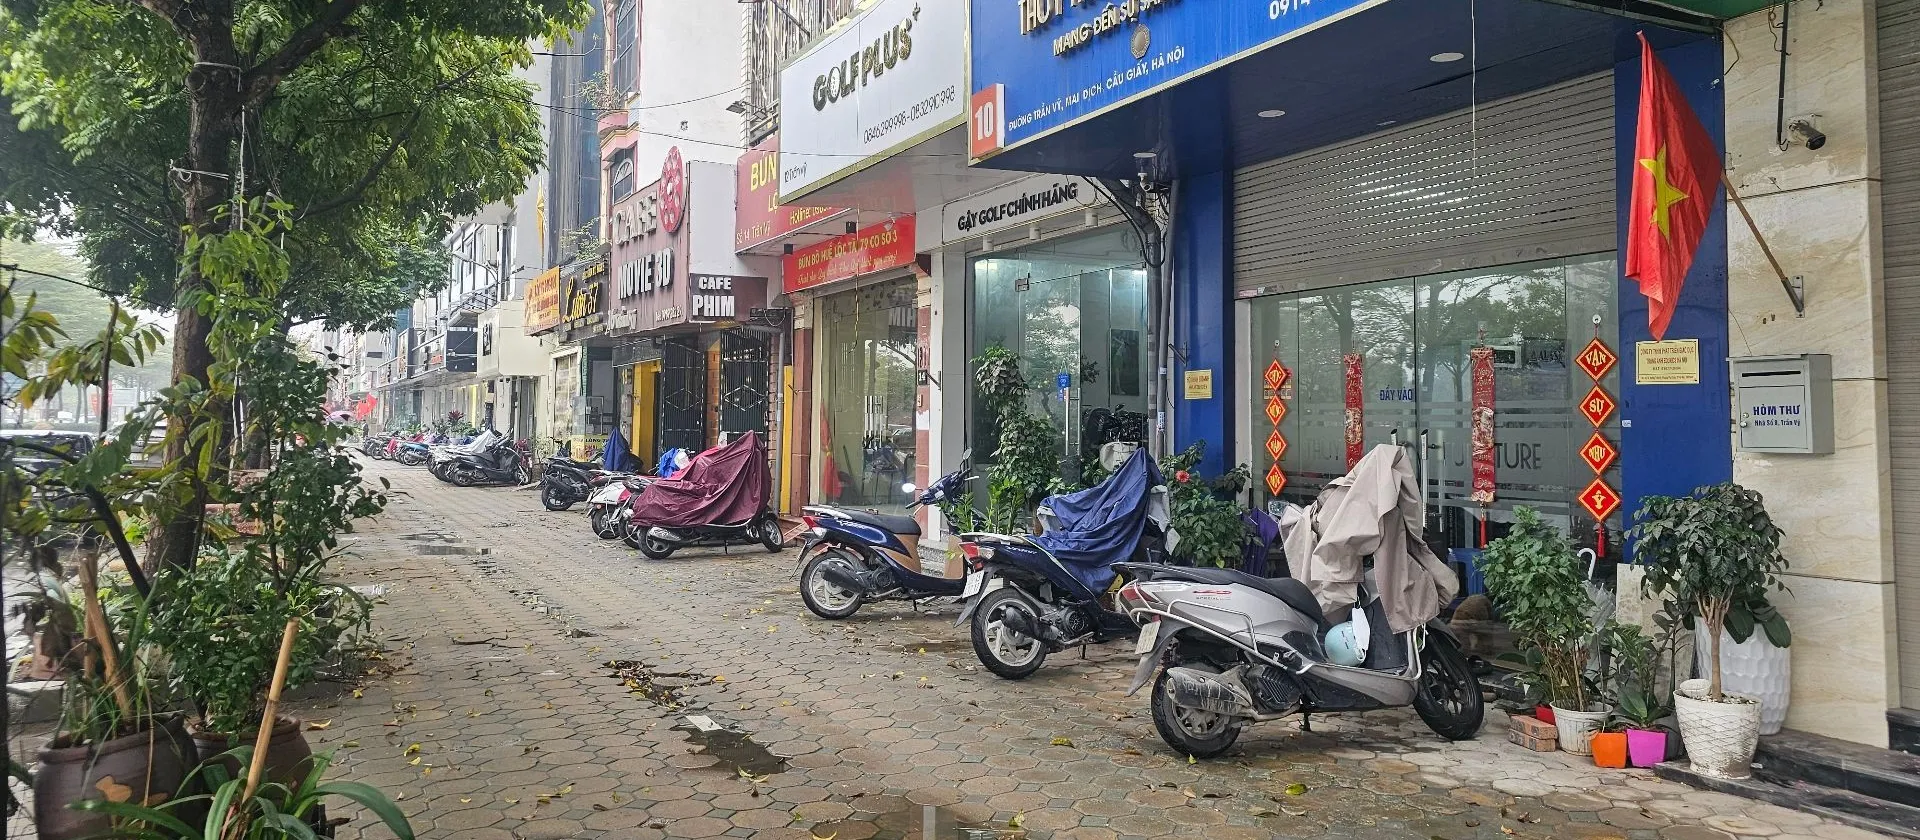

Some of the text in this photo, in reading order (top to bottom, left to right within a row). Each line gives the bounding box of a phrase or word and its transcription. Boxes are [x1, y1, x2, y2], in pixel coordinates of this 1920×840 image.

[1053, 22, 1093, 56] MANG
[1093, 1, 1120, 36] ĐẾN
[1008, 113, 1033, 131] ĐƯỜNG
[1065, 93, 1079, 107] MAI
[1106, 70, 1124, 90] CẦU
[1126, 58, 1149, 80] GIẤY,
[1151, 53, 1165, 71] HÀ
[1167, 46, 1185, 65] NỘI
[974, 102, 994, 139] 10
[751, 150, 777, 192] BÚN
[612, 193, 657, 246] CAFE
[957, 182, 1078, 233] GẬY GOLF CHÍNH HÃNG
[892, 229, 898, 243] 3
[617, 252, 655, 300] MOVIE
[655, 246, 675, 289] 3D
[698, 276, 732, 290] CAFE
[692, 294, 736, 317] PHIM
[918, 371, 926, 381] 14
[1397, 386, 1413, 401] VÀO
[1752, 403, 1801, 416] HÒM THƯ
